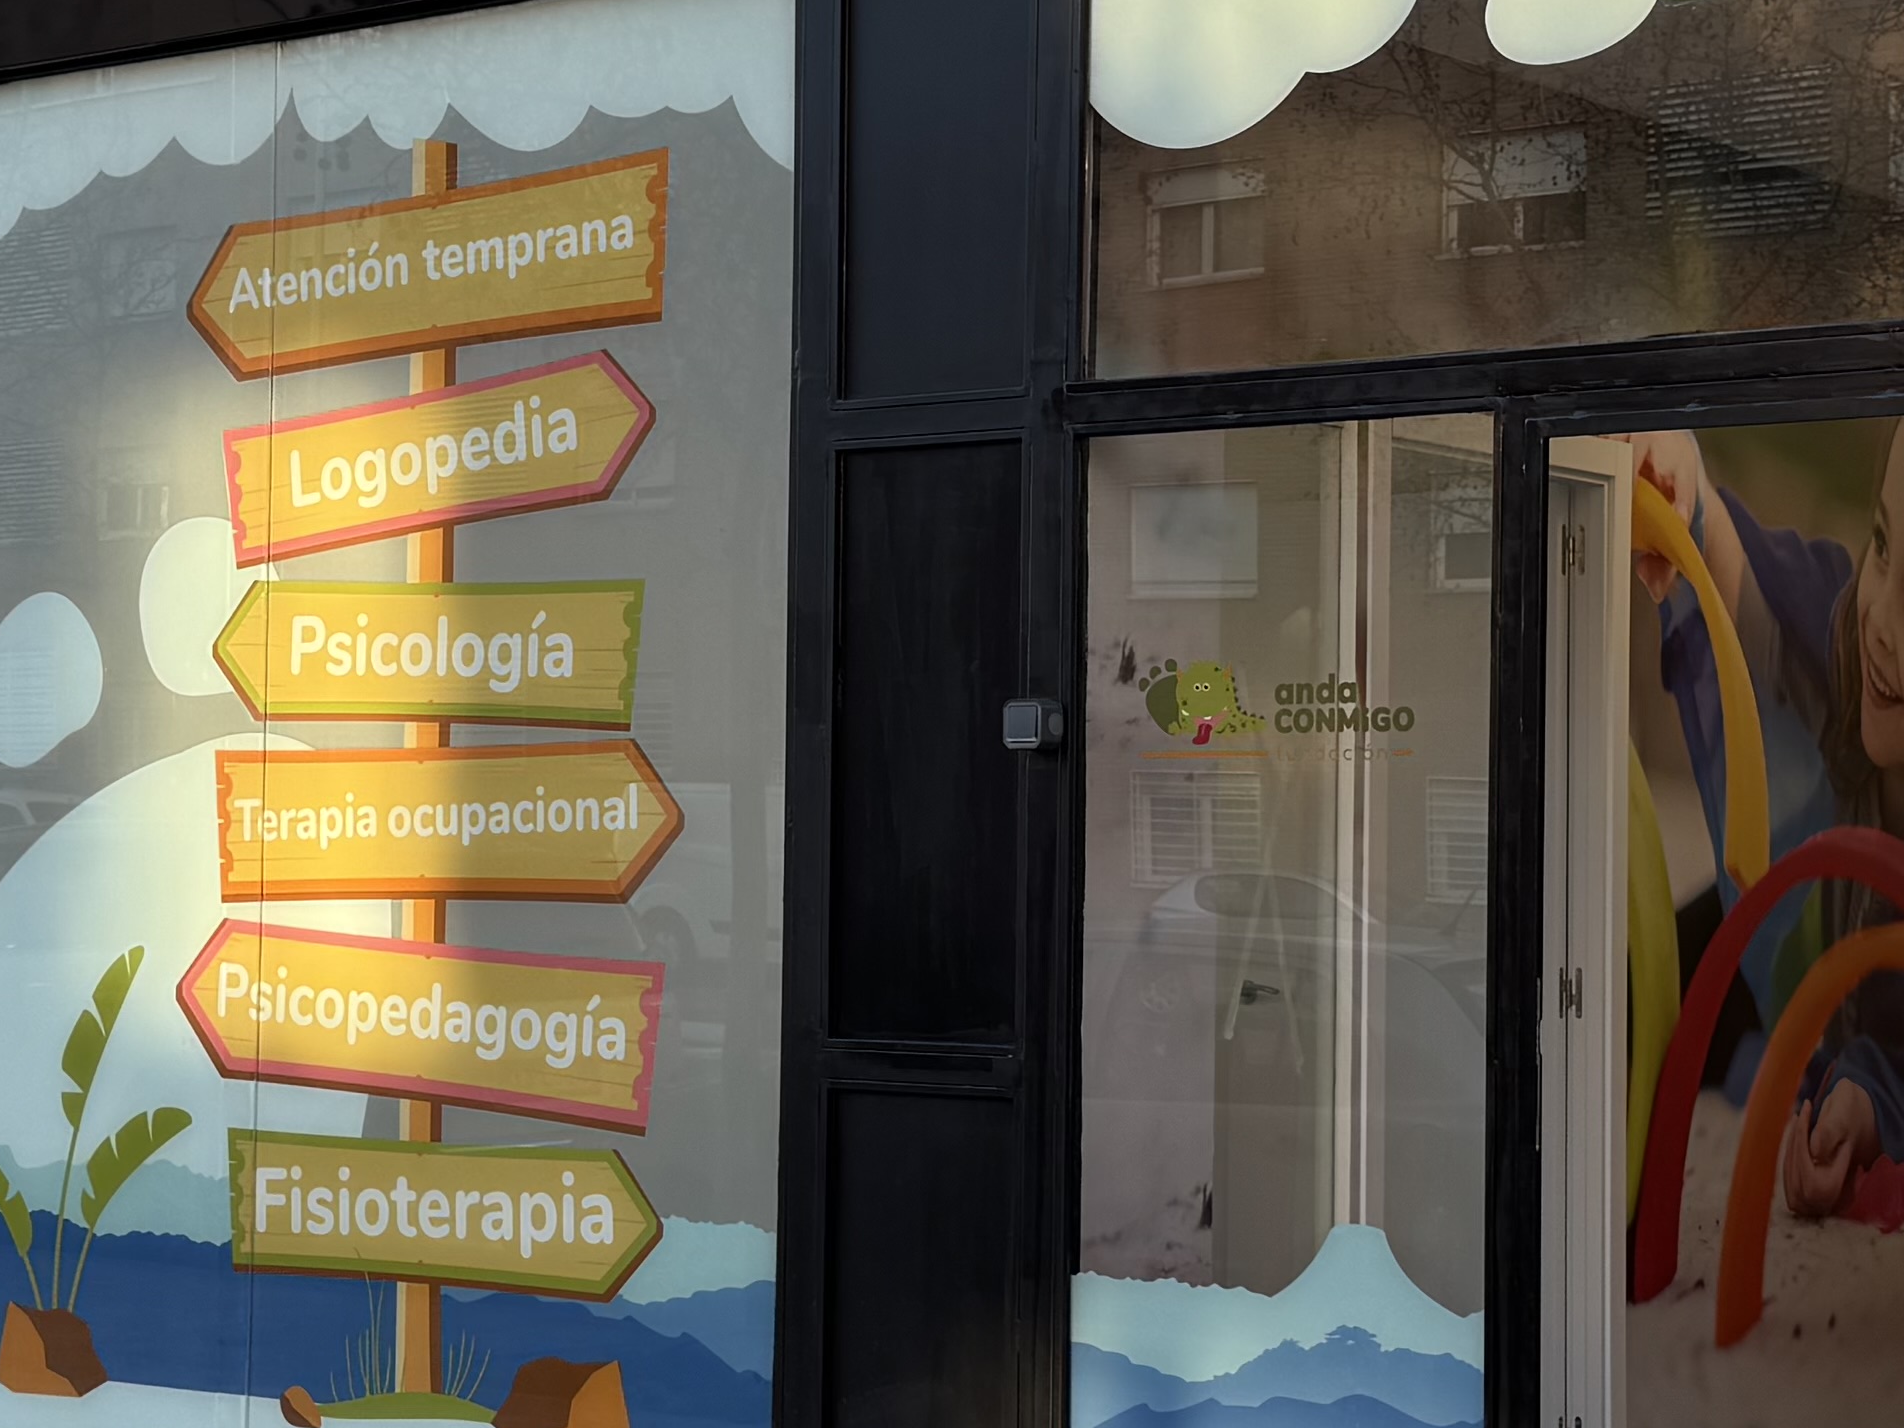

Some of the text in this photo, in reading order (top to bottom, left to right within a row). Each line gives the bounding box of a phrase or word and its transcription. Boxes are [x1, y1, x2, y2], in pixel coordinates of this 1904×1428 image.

[228, 214, 635, 314] Atención temprana
[289, 395, 579, 509] Logopedia
[289, 610, 575, 693] Psicología
[1274, 673, 1357, 705] anda
[233, 786, 639, 850] Terapia ocupacional
[215, 960, 627, 1069] Psicopedagogía
[253, 1165, 615, 1259] Fisioterapia
